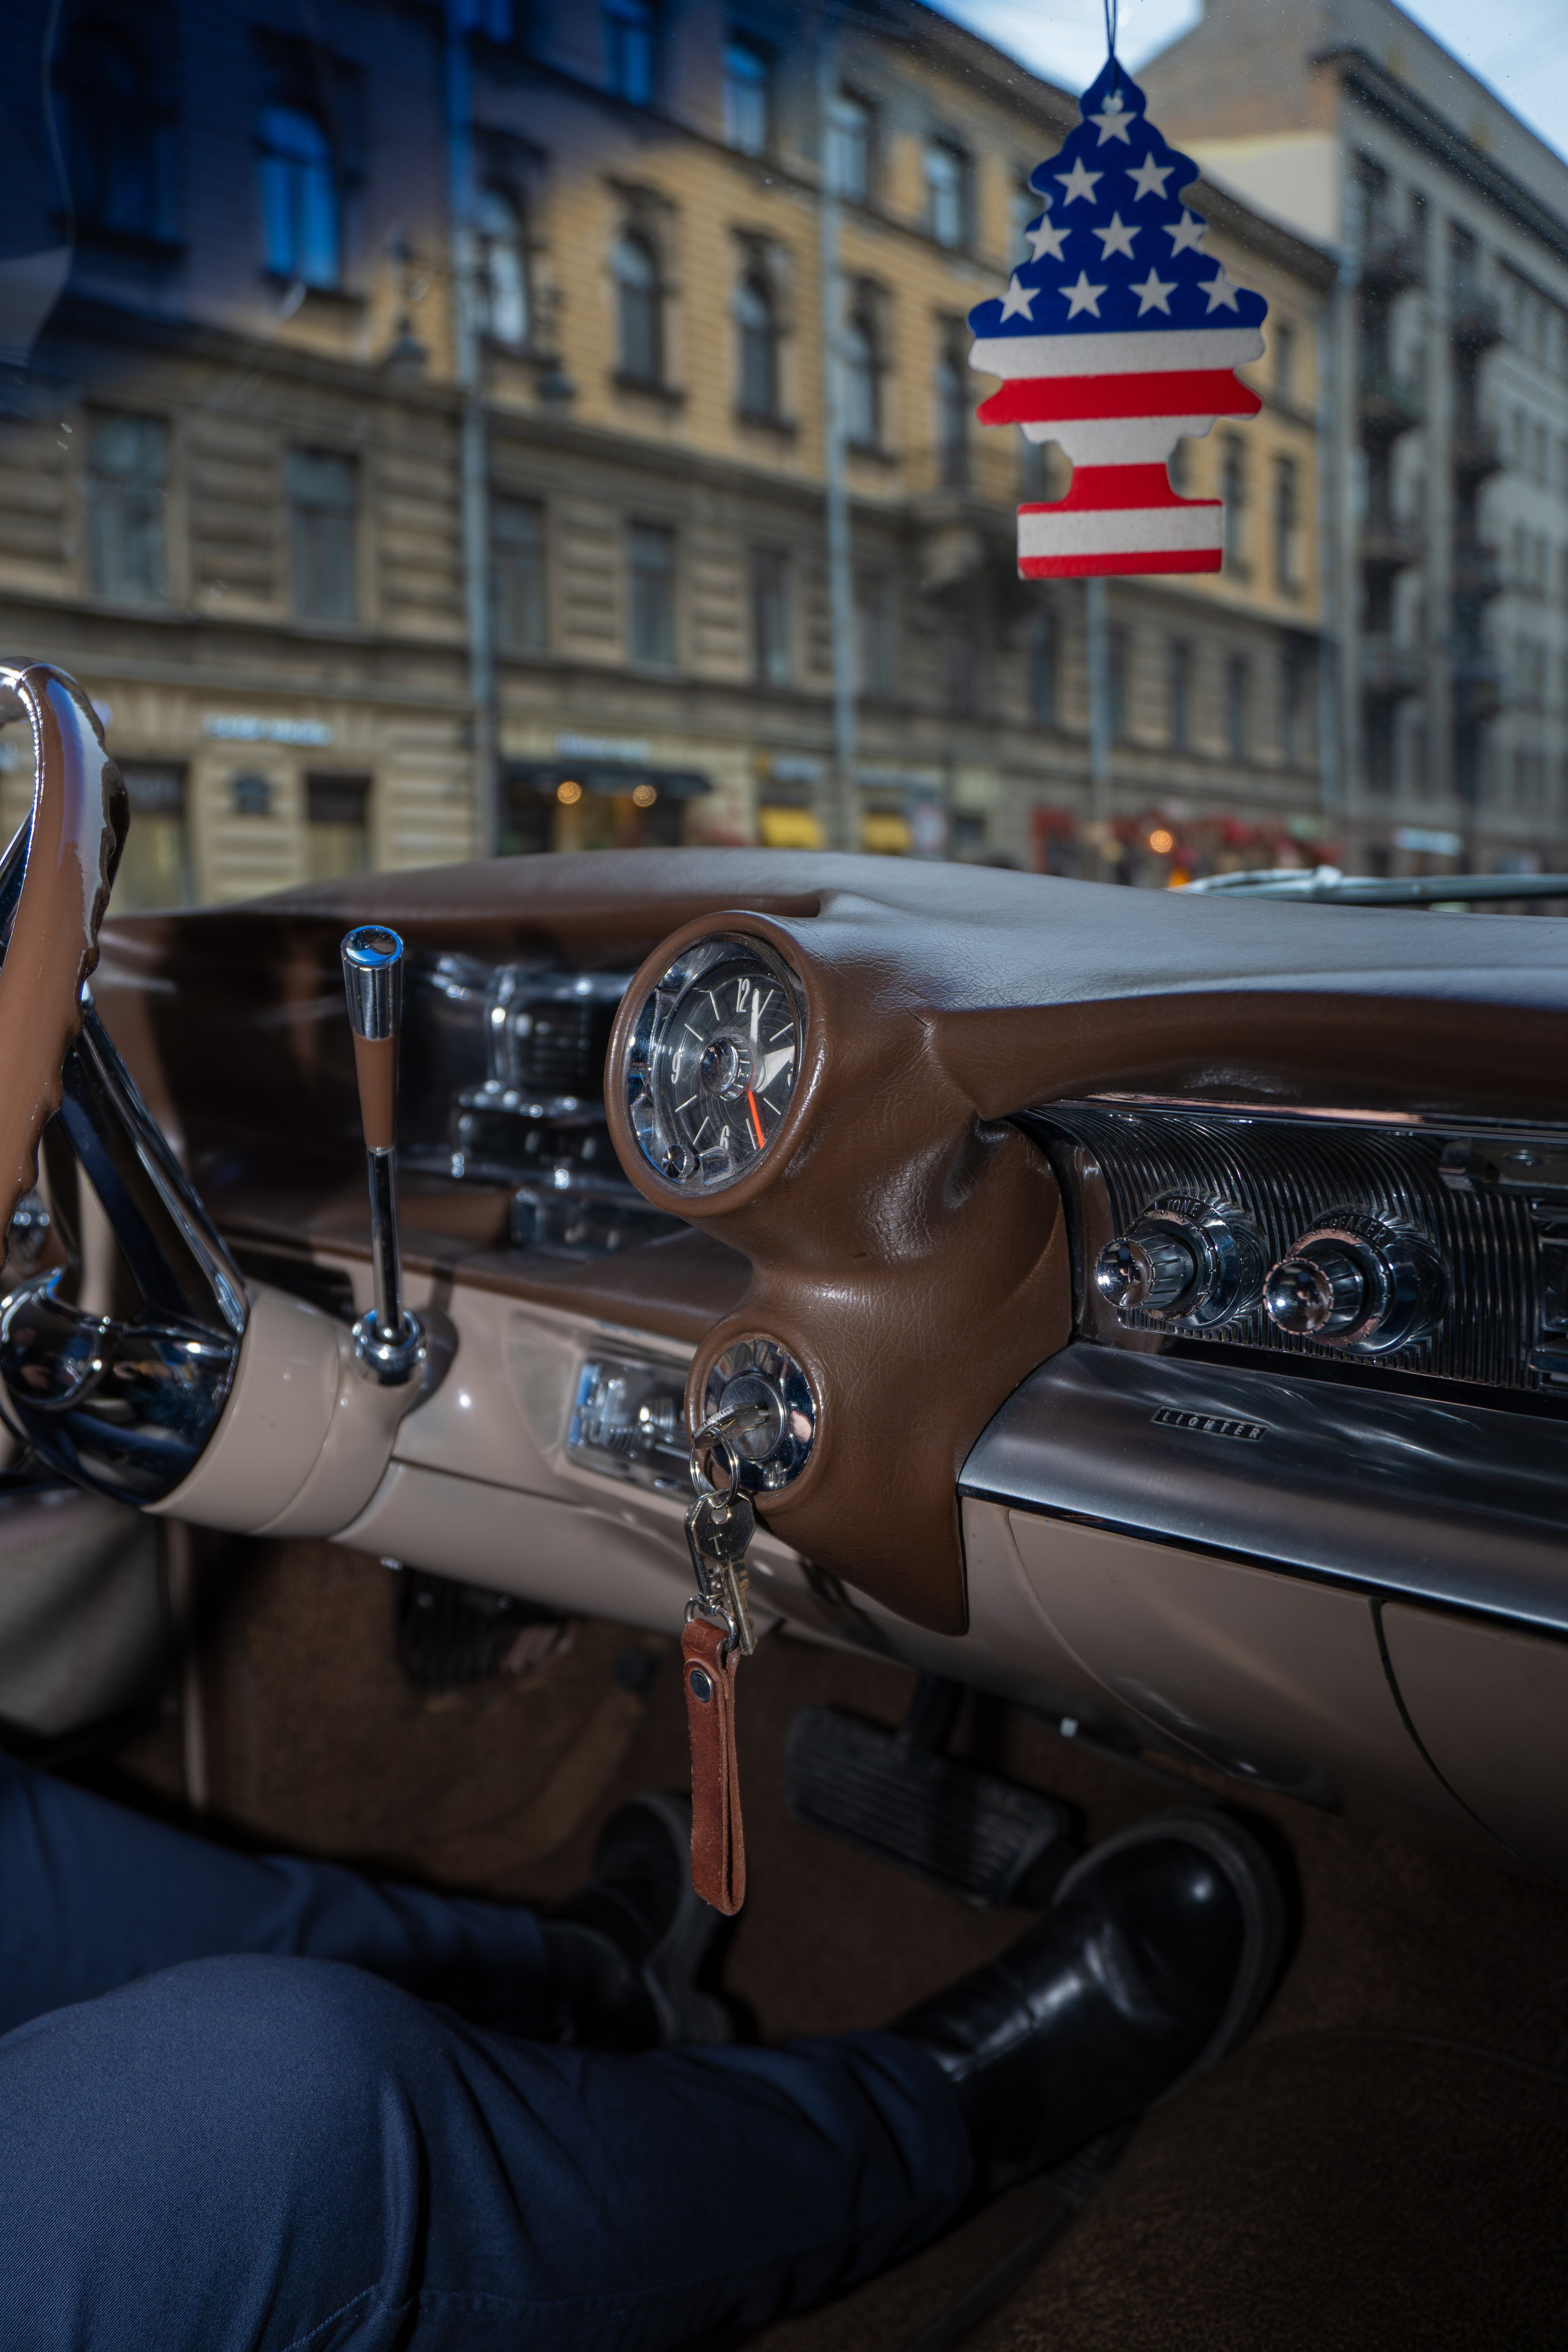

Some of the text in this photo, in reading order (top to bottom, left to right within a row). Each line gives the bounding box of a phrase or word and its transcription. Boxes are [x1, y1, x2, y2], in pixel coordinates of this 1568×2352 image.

[736, 978, 750, 1012] 12
[671, 1052, 681, 1084] 9
[720, 1125, 729, 1150] 6
[1167, 1199, 1201, 1217] TONE
[1163, 1411, 1261, 1439] LIGHTER
